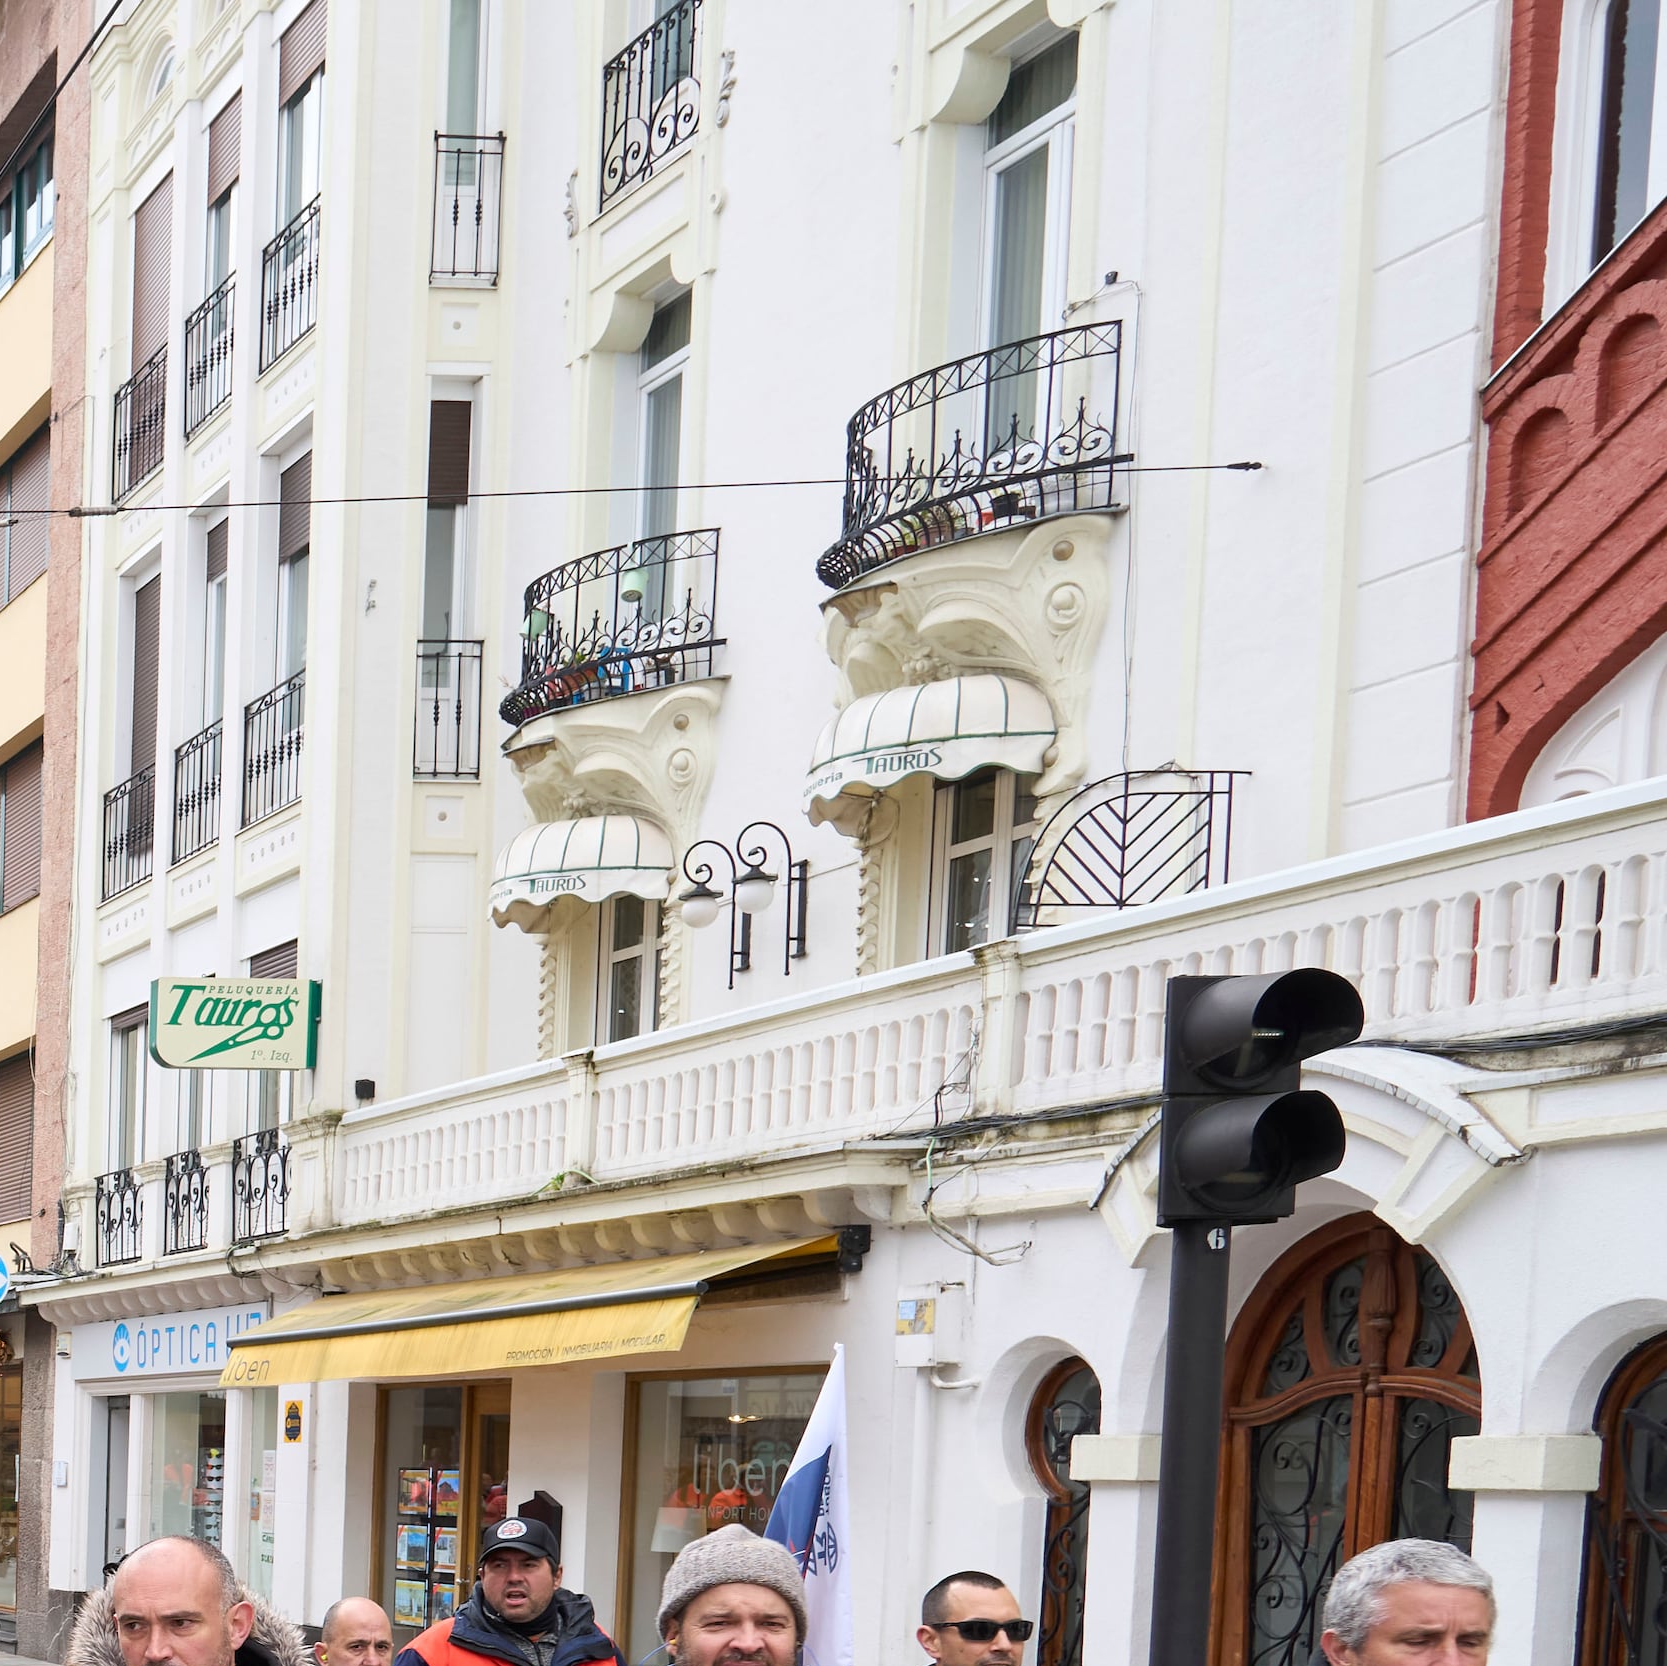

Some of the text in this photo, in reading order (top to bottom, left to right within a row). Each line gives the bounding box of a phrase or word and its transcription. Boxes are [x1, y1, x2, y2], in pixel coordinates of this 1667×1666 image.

[852, 746, 943, 775] TAUROS
[519, 873, 587, 894] TAUROS
[208, 984, 299, 995] PELUQUERÍA
[270, 1050, 293, 1062] Izq.
[1207, 1228, 1226, 1250] 6
[136, 1321, 219, 1369] ÓPTICA
[621, 1333, 666, 1346] MODULAR
[695, 1505, 747, 1521] NFORT
